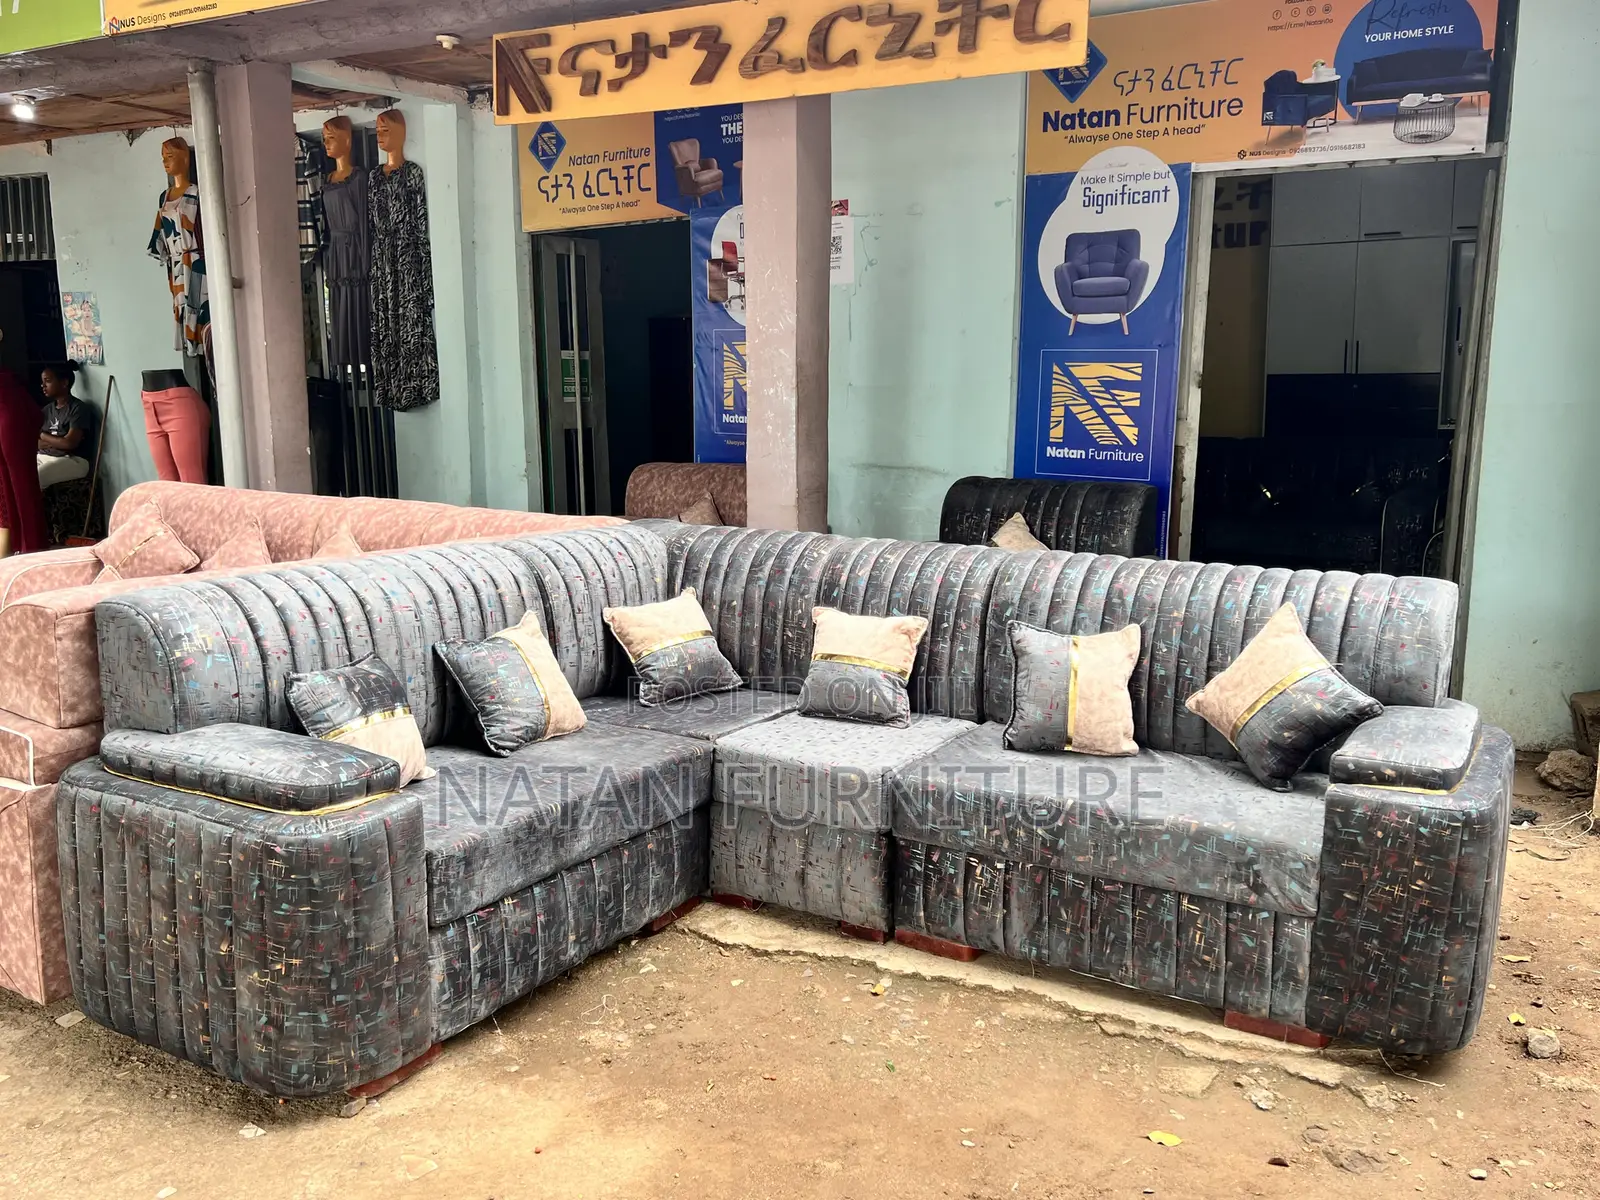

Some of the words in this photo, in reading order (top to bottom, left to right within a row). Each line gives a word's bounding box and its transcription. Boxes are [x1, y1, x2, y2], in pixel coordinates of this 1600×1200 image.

[120, 18, 136, 28] NUS
[137, 12, 166, 25] Designs
[1364, 32, 1392, 42] YOUR
[1394, 28, 1423, 40] HOME
[1425, 25, 1454, 36] STYLE
[557, 25, 732, 96] ናታን
[1113, 68, 1156, 96] ናታን
[1161, 58, 1244, 92] ፈርኒቸር
[1042, 108, 1120, 132] Natan
[1127, 96, 1244, 126] Furniture
[720, 122, 742, 136] THE
[1112, 132, 1133, 141] One
[1136, 129, 1160, 140] Step
[1162, 128, 1170, 136] A
[568, 154, 600, 167] Natan
[602, 147, 650, 162] Furniture
[538, 173, 575, 203] ናታን
[583, 162, 652, 198] ፈርኒቸር
[1080, 176, 1106, 185] Make
[1108, 174, 1115, 182] It
[1117, 172, 1151, 184] Simple
[1154, 170, 1170, 180] but
[600, 202, 614, 212] Step
[1082, 184, 1170, 214] Significant
[1046, 446, 1086, 459] Natan
[1088, 448, 1144, 462] Furniture
